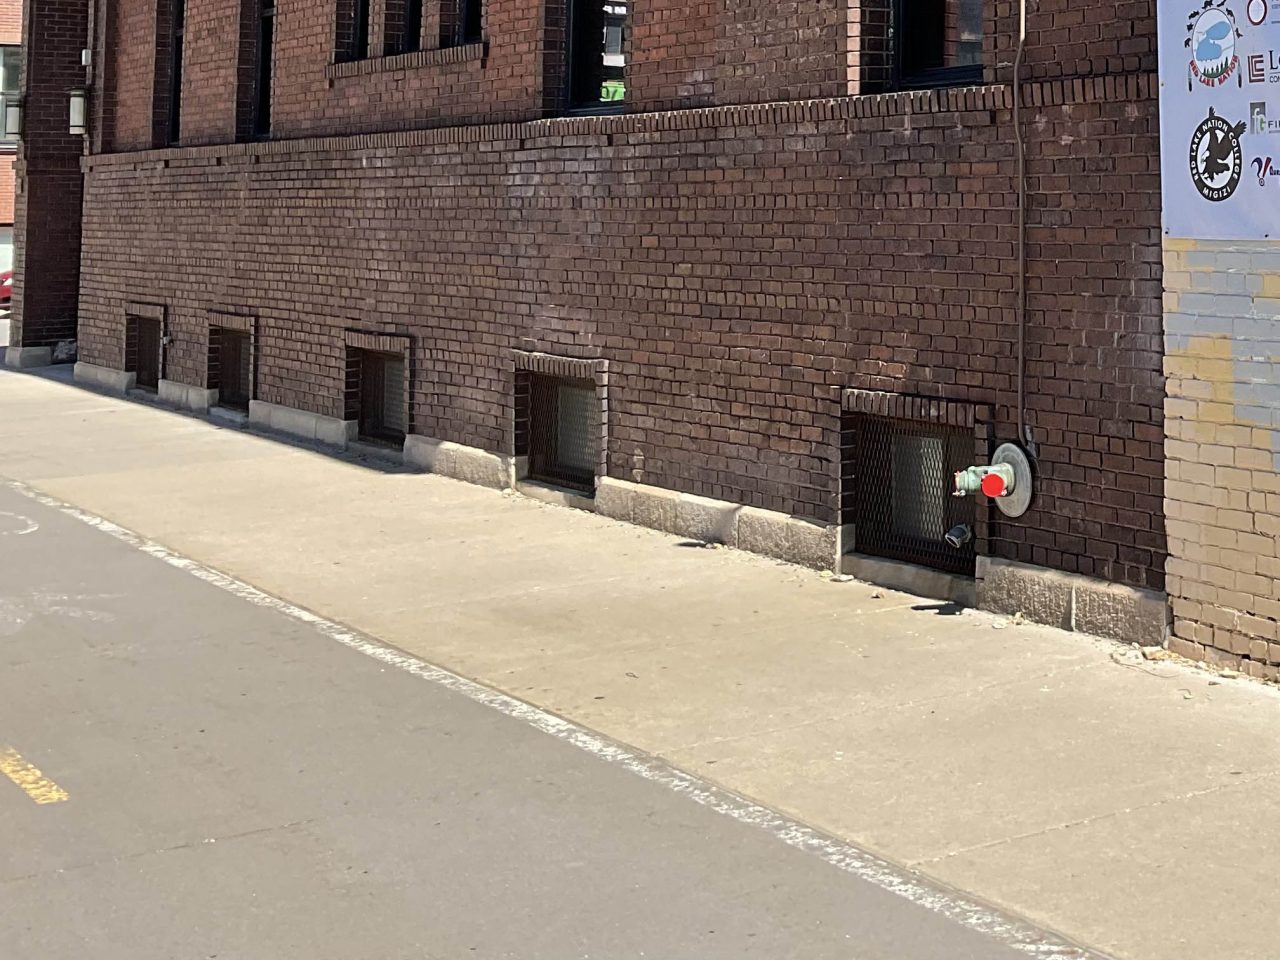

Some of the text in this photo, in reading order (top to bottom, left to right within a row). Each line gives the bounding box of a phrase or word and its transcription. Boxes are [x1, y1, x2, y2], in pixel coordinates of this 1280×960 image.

[1191, 120, 1240, 181] RED LAKE NATION COLLEGE
[1203, 186, 1231, 198] MIGIZI
